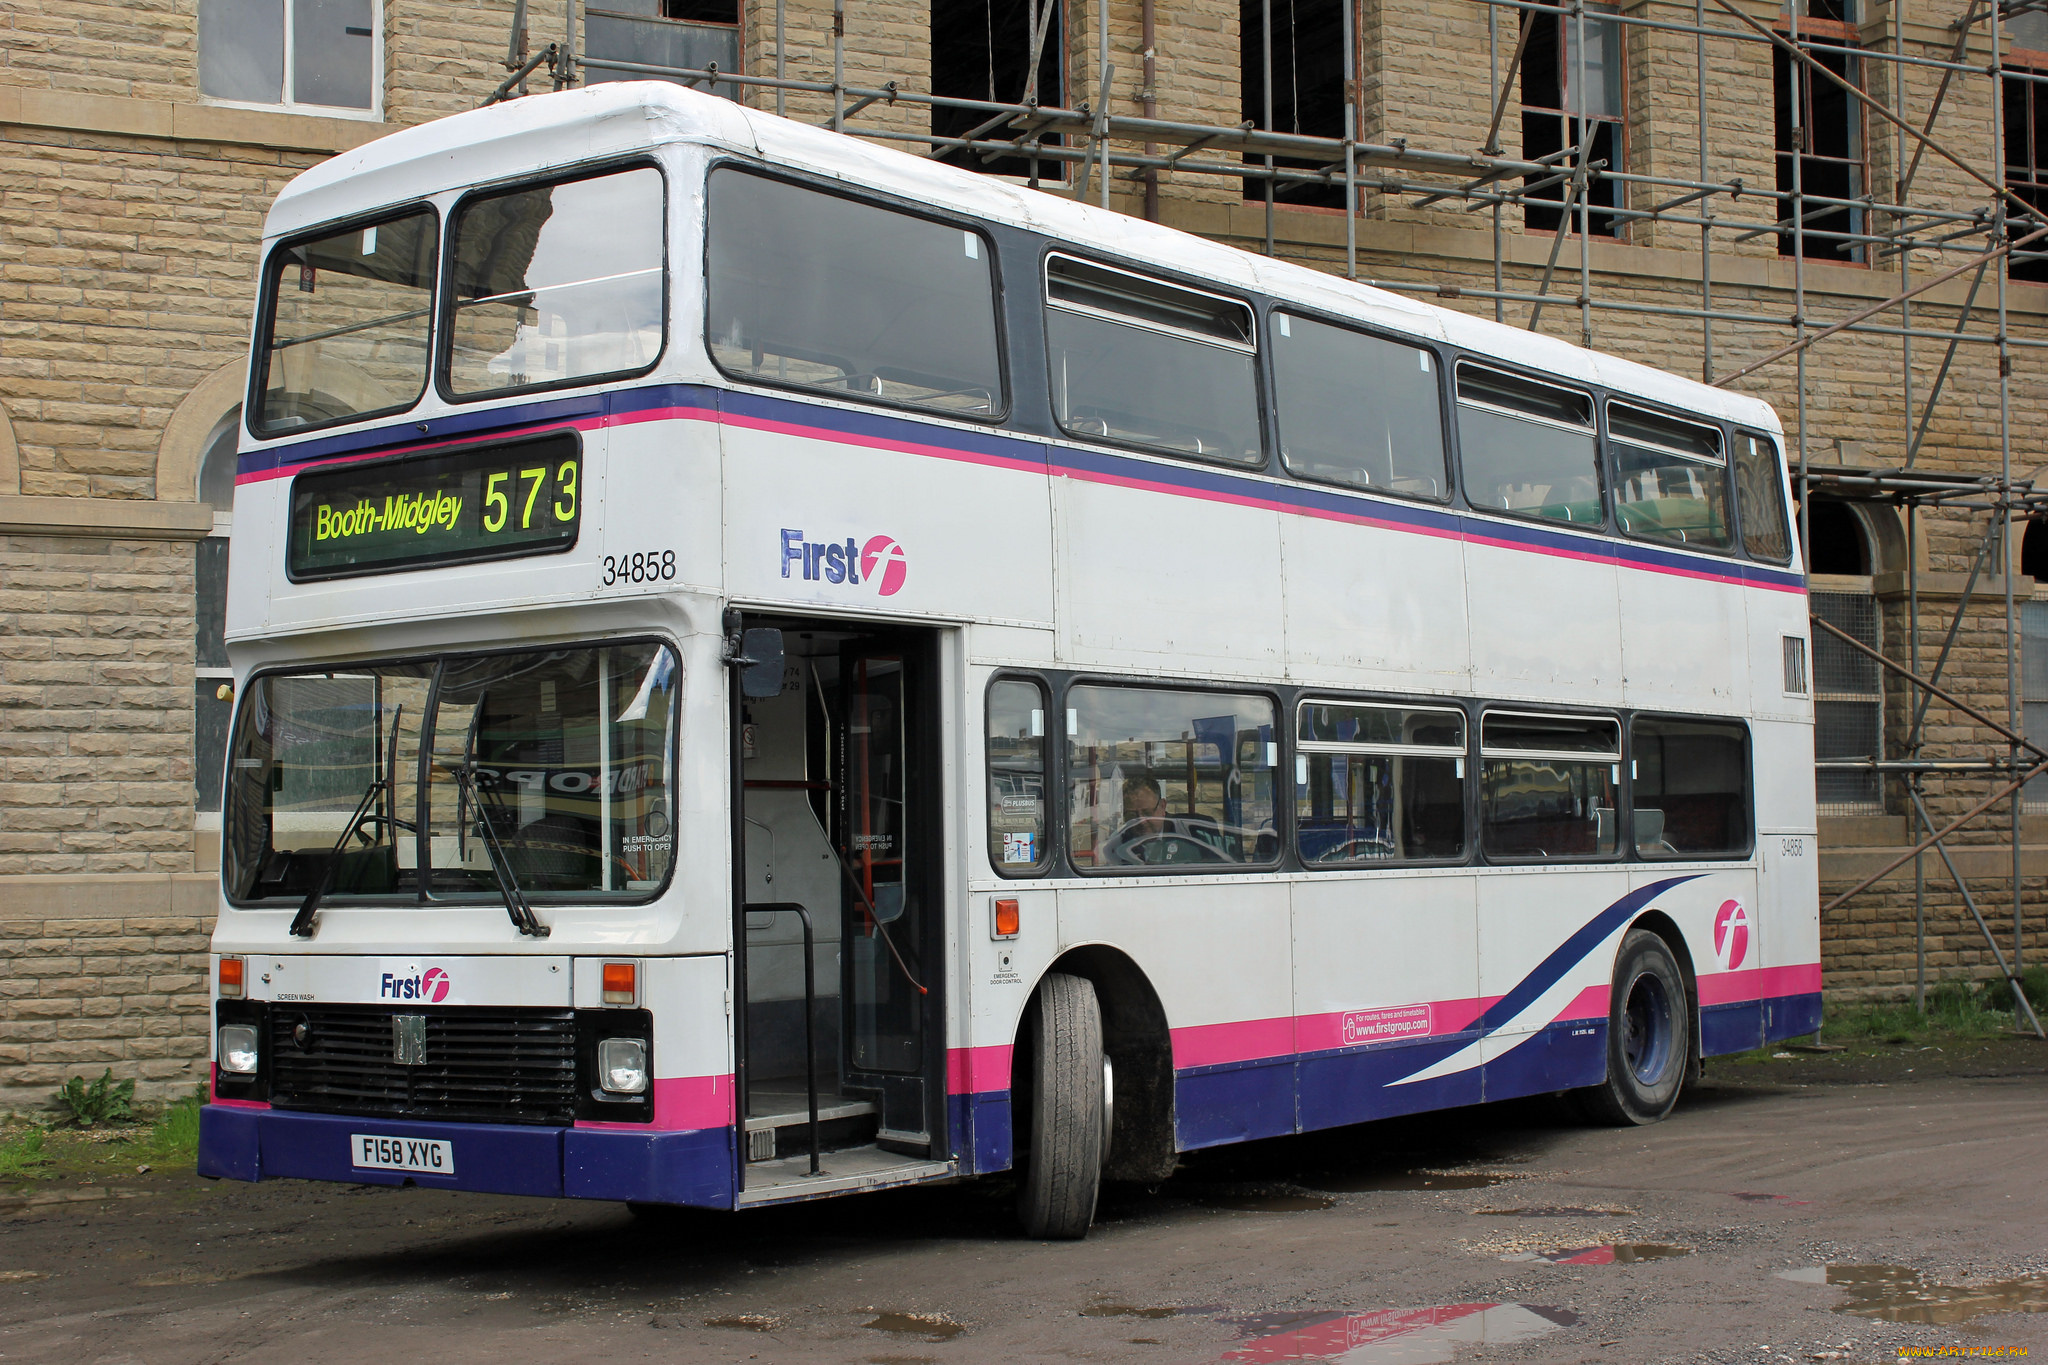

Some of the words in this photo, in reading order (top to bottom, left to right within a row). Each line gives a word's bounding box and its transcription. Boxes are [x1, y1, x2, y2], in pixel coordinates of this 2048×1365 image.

[316, 489, 463, 541] Booth-Midgley
[483, 460, 577, 533] 573
[780, 528, 859, 585] First
[602, 549, 676, 586] 34858
[1012, 799, 1035, 807] PLUSBUS
[622, 836, 630, 844] IN
[631, 834, 672, 843] EMERGENCY
[623, 844, 642, 852] PUSH
[1781, 838, 1803, 857] 34858
[381, 973, 421, 999] First
[277, 993, 299, 1001] SCREEN
[299, 993, 315, 1001] WASH
[1355, 1014, 1364, 1022] For
[1381, 1011, 1393, 1020] fares
[1393, 1010, 1402, 1019] and
[1402, 1008, 1426, 1018] timetables
[1355, 1018, 1428, 1036] www.firstgroup.com
[363, 1138, 403, 1165] F158
[407, 1141, 442, 1168] XYG
